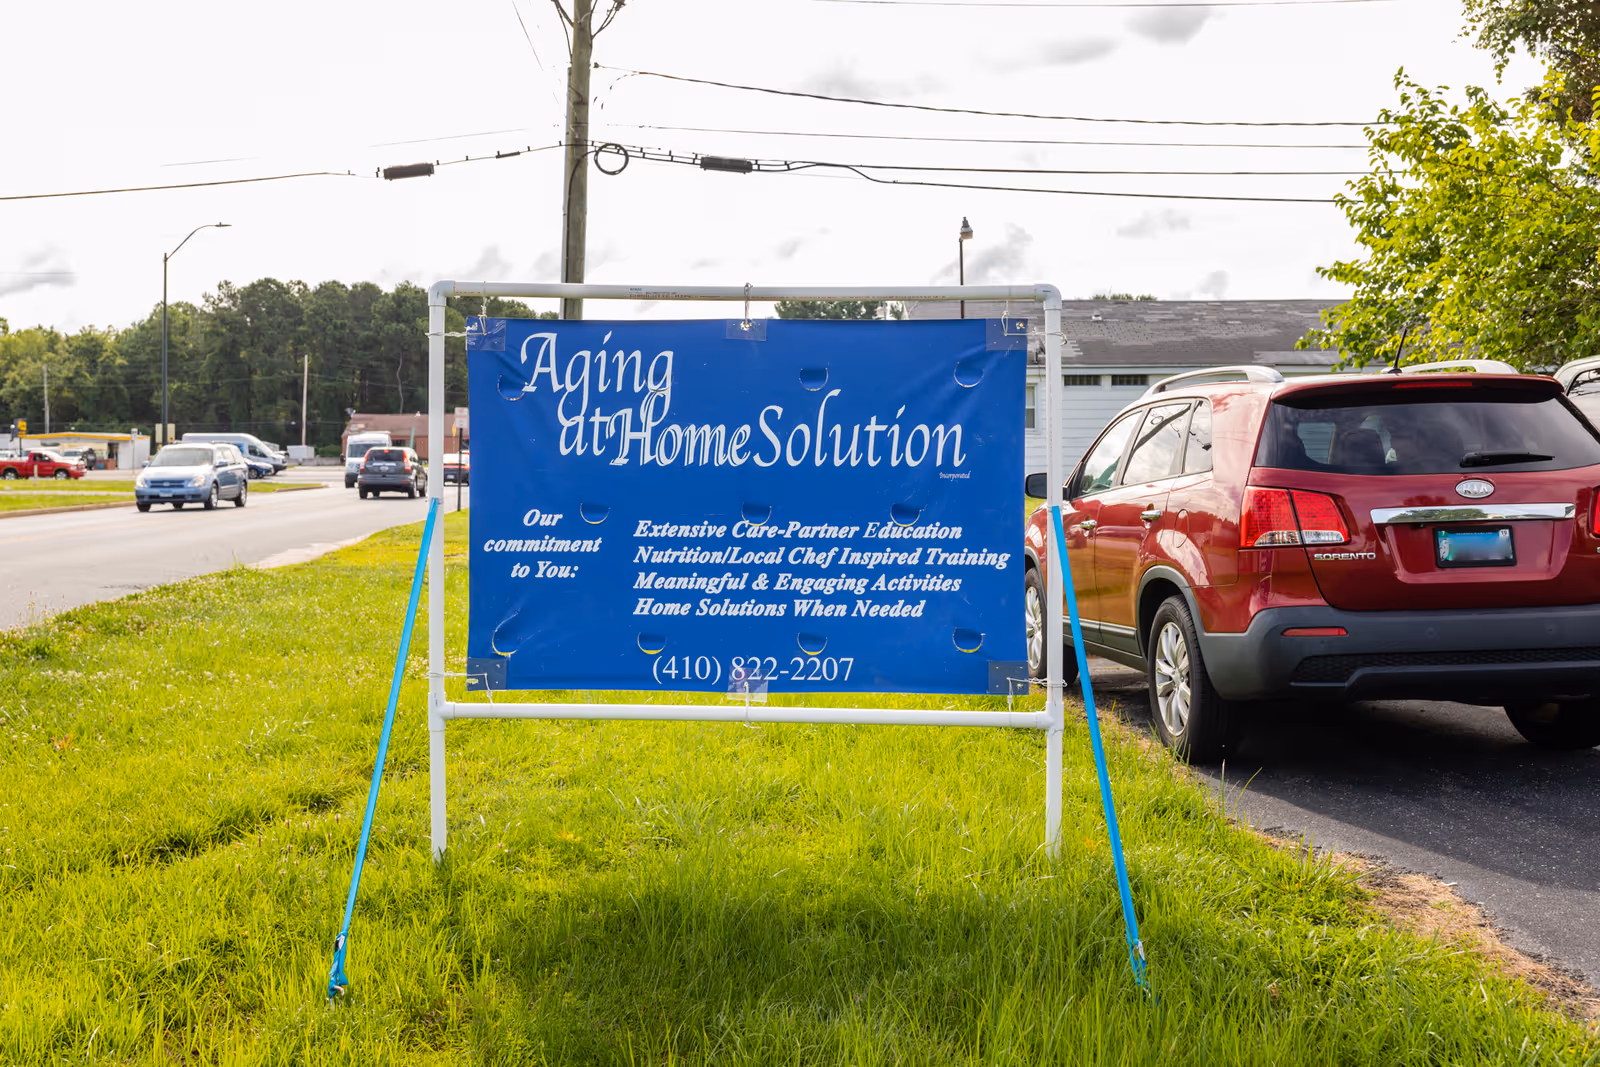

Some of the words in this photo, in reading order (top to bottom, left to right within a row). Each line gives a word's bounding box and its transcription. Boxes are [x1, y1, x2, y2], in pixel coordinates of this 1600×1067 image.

[520, 331, 674, 427] Aging
[939, 471, 971, 481] Incorporated
[522, 508, 563, 527] Our
[632, 519, 727, 538] Extensive
[731, 520, 860, 539] Care-Partner
[862, 521, 963, 539] Education
[483, 534, 602, 553] commitment
[632, 545, 786, 565] Nutrition/Local
[788, 546, 839, 569] Chef
[838, 547, 923, 569] Inspired
[925, 548, 1011, 570] Training
[1314, 552, 1376, 561] SORENTO
[510, 562, 531, 578] to
[533, 560, 579, 579] You:
[632, 571, 749, 594] Meaningful
[751, 572, 769, 591] &
[773, 573, 869, 595] Engaging
[870, 573, 963, 592] Activities
[632, 597, 692, 616] Home
[695, 598, 788, 617] Solutions
[792, 598, 848, 617] When
[850, 599, 927, 618] Needed
[652, 655, 722, 685] (410)
[731, 656, 854, 682] 822-2207
